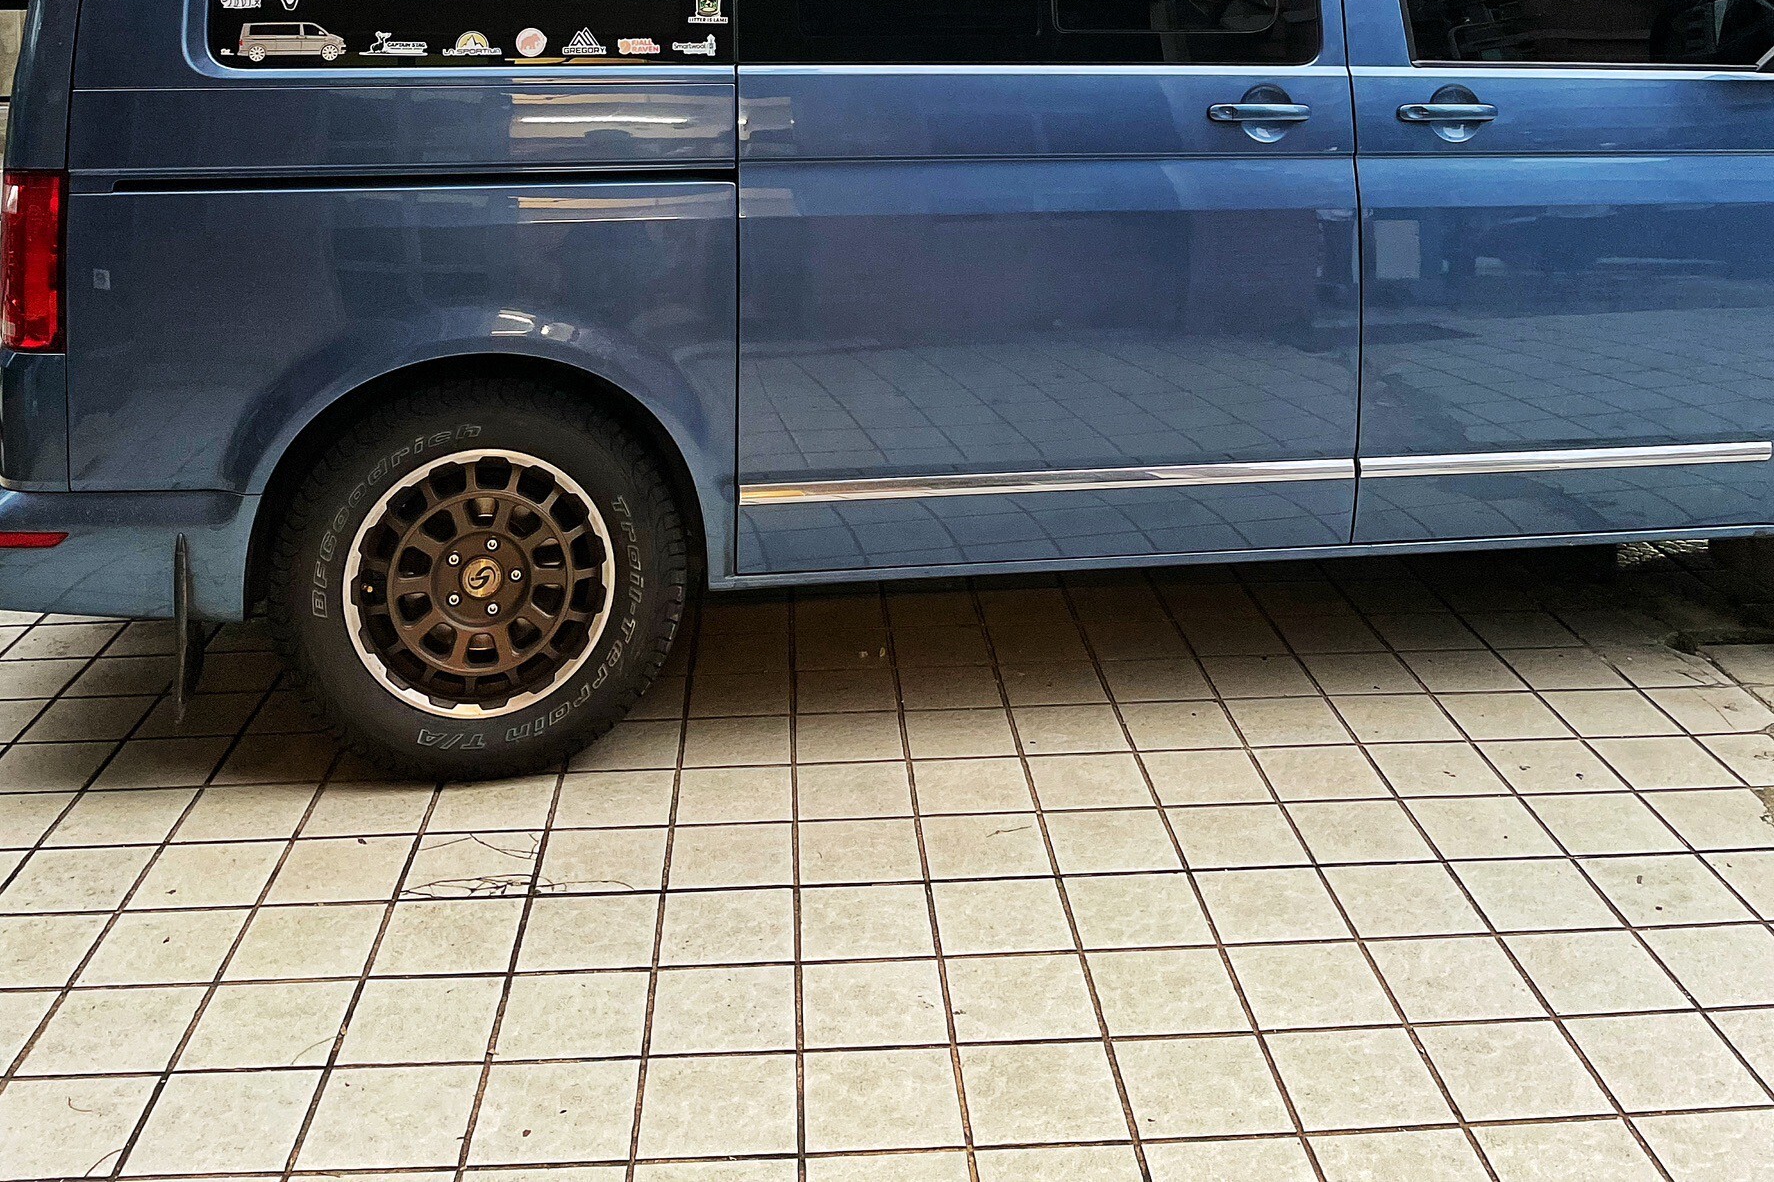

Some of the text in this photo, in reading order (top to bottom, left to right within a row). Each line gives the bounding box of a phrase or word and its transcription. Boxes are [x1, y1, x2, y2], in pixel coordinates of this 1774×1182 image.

[563, 46, 606, 54] GREGORY
[311, 423, 482, 619] BFGoodrich
[416, 728, 487, 750] T/A
